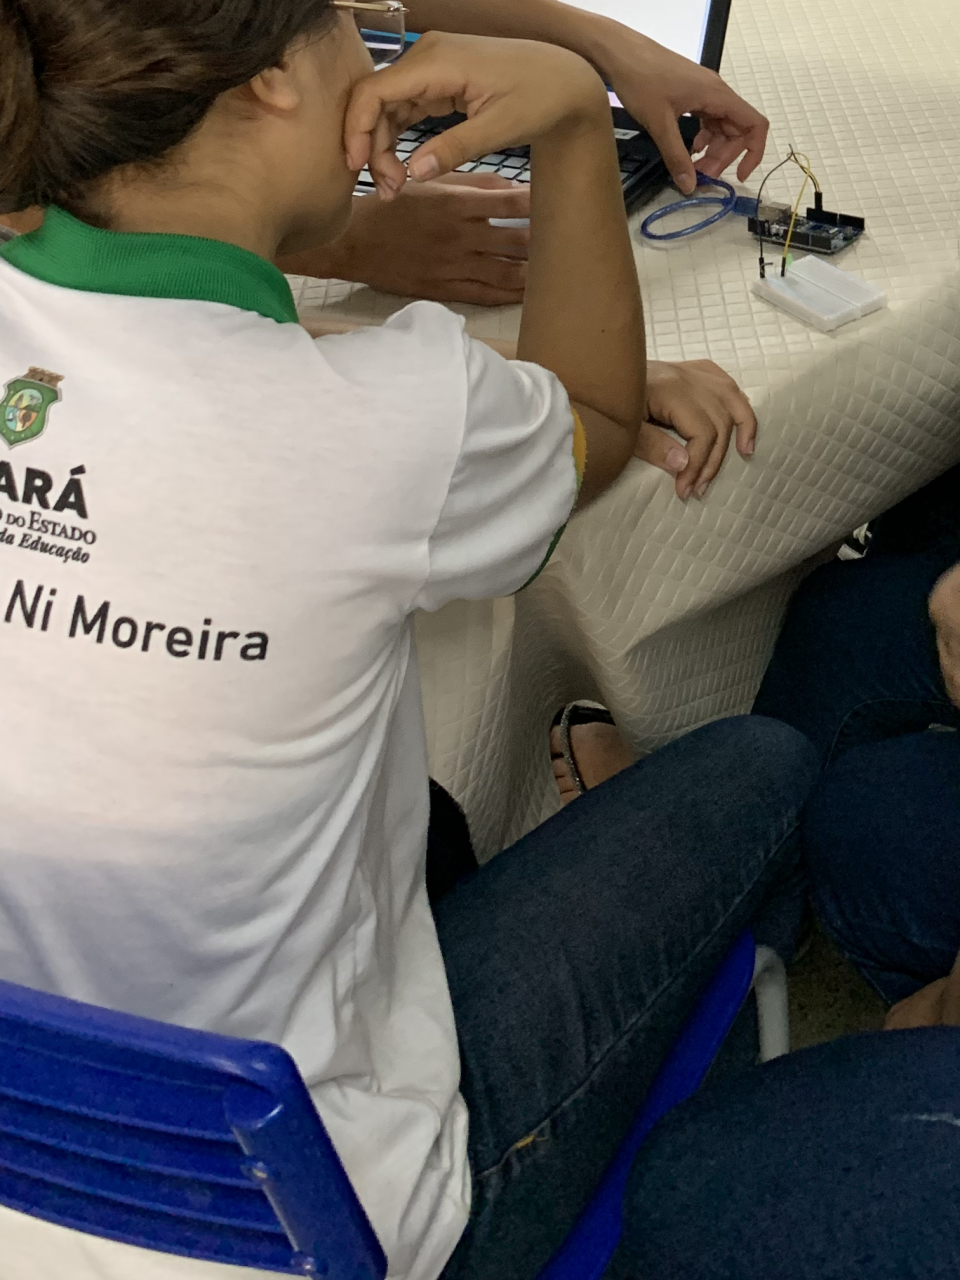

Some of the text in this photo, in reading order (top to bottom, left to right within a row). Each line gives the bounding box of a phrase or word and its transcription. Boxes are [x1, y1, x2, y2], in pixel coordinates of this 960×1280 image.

[18, 533, 90, 563] Educação
[4, 579, 269, 661] Ni Moreira
